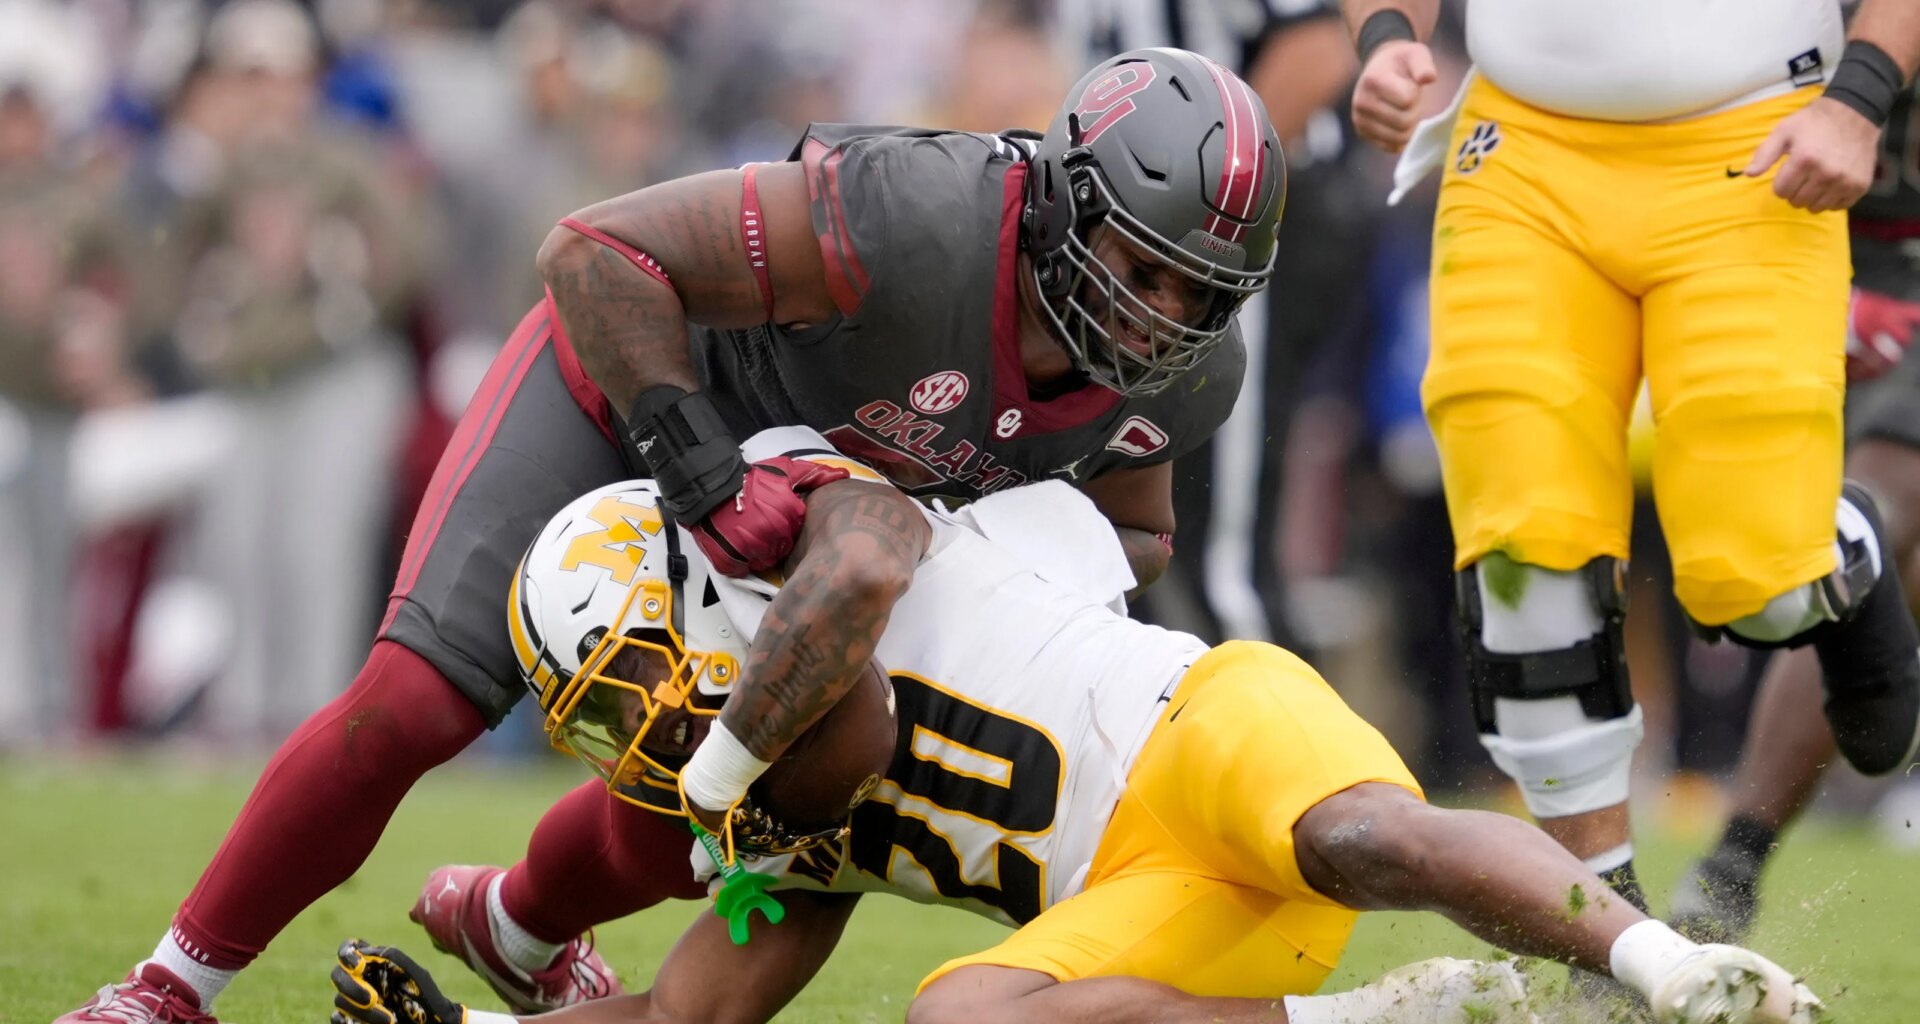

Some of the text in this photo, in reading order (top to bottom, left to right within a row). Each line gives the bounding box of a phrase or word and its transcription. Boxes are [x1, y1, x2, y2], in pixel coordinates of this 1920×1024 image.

[745, 210, 765, 267] JORDAN
[1200, 235, 1238, 257] UNITY
[912, 372, 967, 412] SEC
[996, 408, 1023, 438] OU
[855, 399, 1036, 497] OKLAHO
[847, 667, 1069, 929] 20
